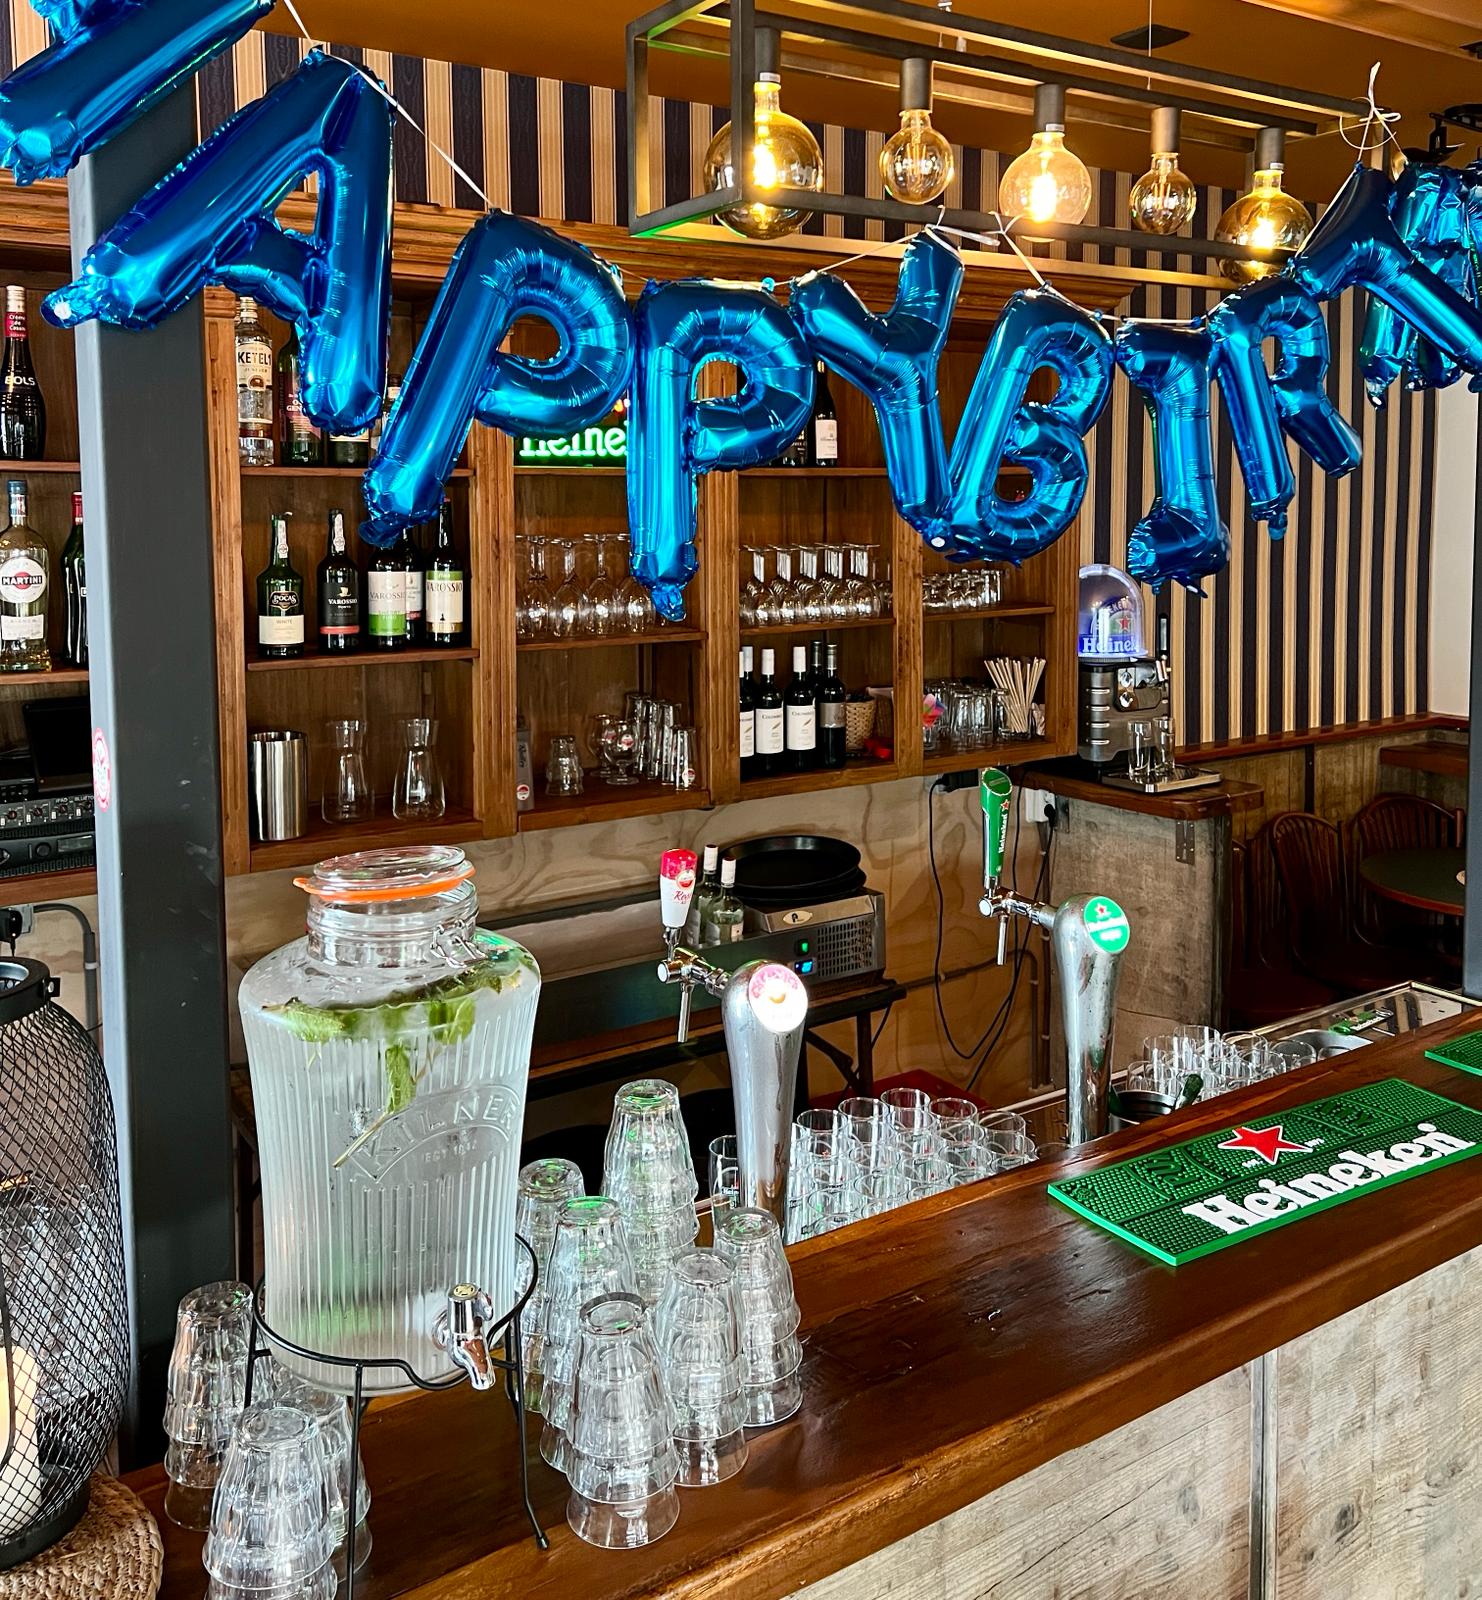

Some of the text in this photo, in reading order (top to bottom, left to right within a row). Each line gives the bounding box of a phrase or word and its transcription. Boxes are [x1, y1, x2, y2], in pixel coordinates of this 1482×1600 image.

[0, 0, 964, 622] APPY
[4, 375, 36, 386] BOLS
[2, 575, 42, 585] MARTINI
[426, 582, 463, 593] VAROSSIO
[369, 592, 406, 600] VAROSSI
[357, 1094, 517, 1172] KILNER
[1182, 1128, 1477, 1235] Heineken
